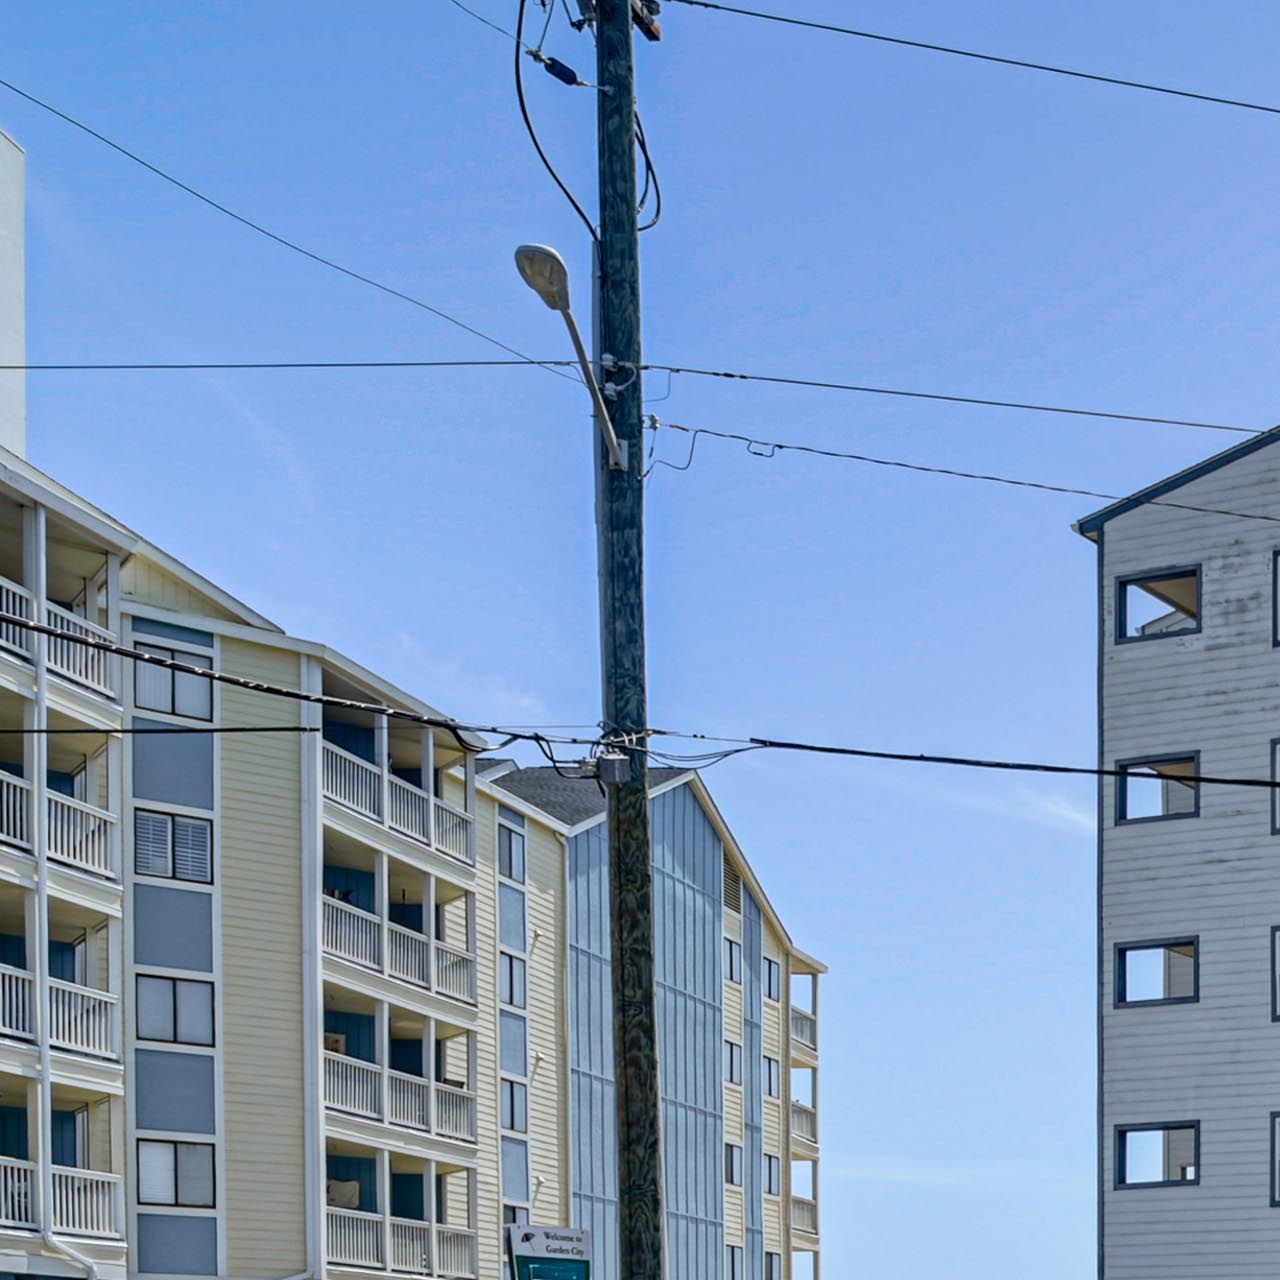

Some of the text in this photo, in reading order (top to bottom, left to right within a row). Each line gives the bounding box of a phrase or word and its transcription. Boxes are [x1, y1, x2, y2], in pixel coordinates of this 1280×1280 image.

[543, 1231, 583, 1243] Welcome to
[545, 1244, 585, 1258] Garden City
